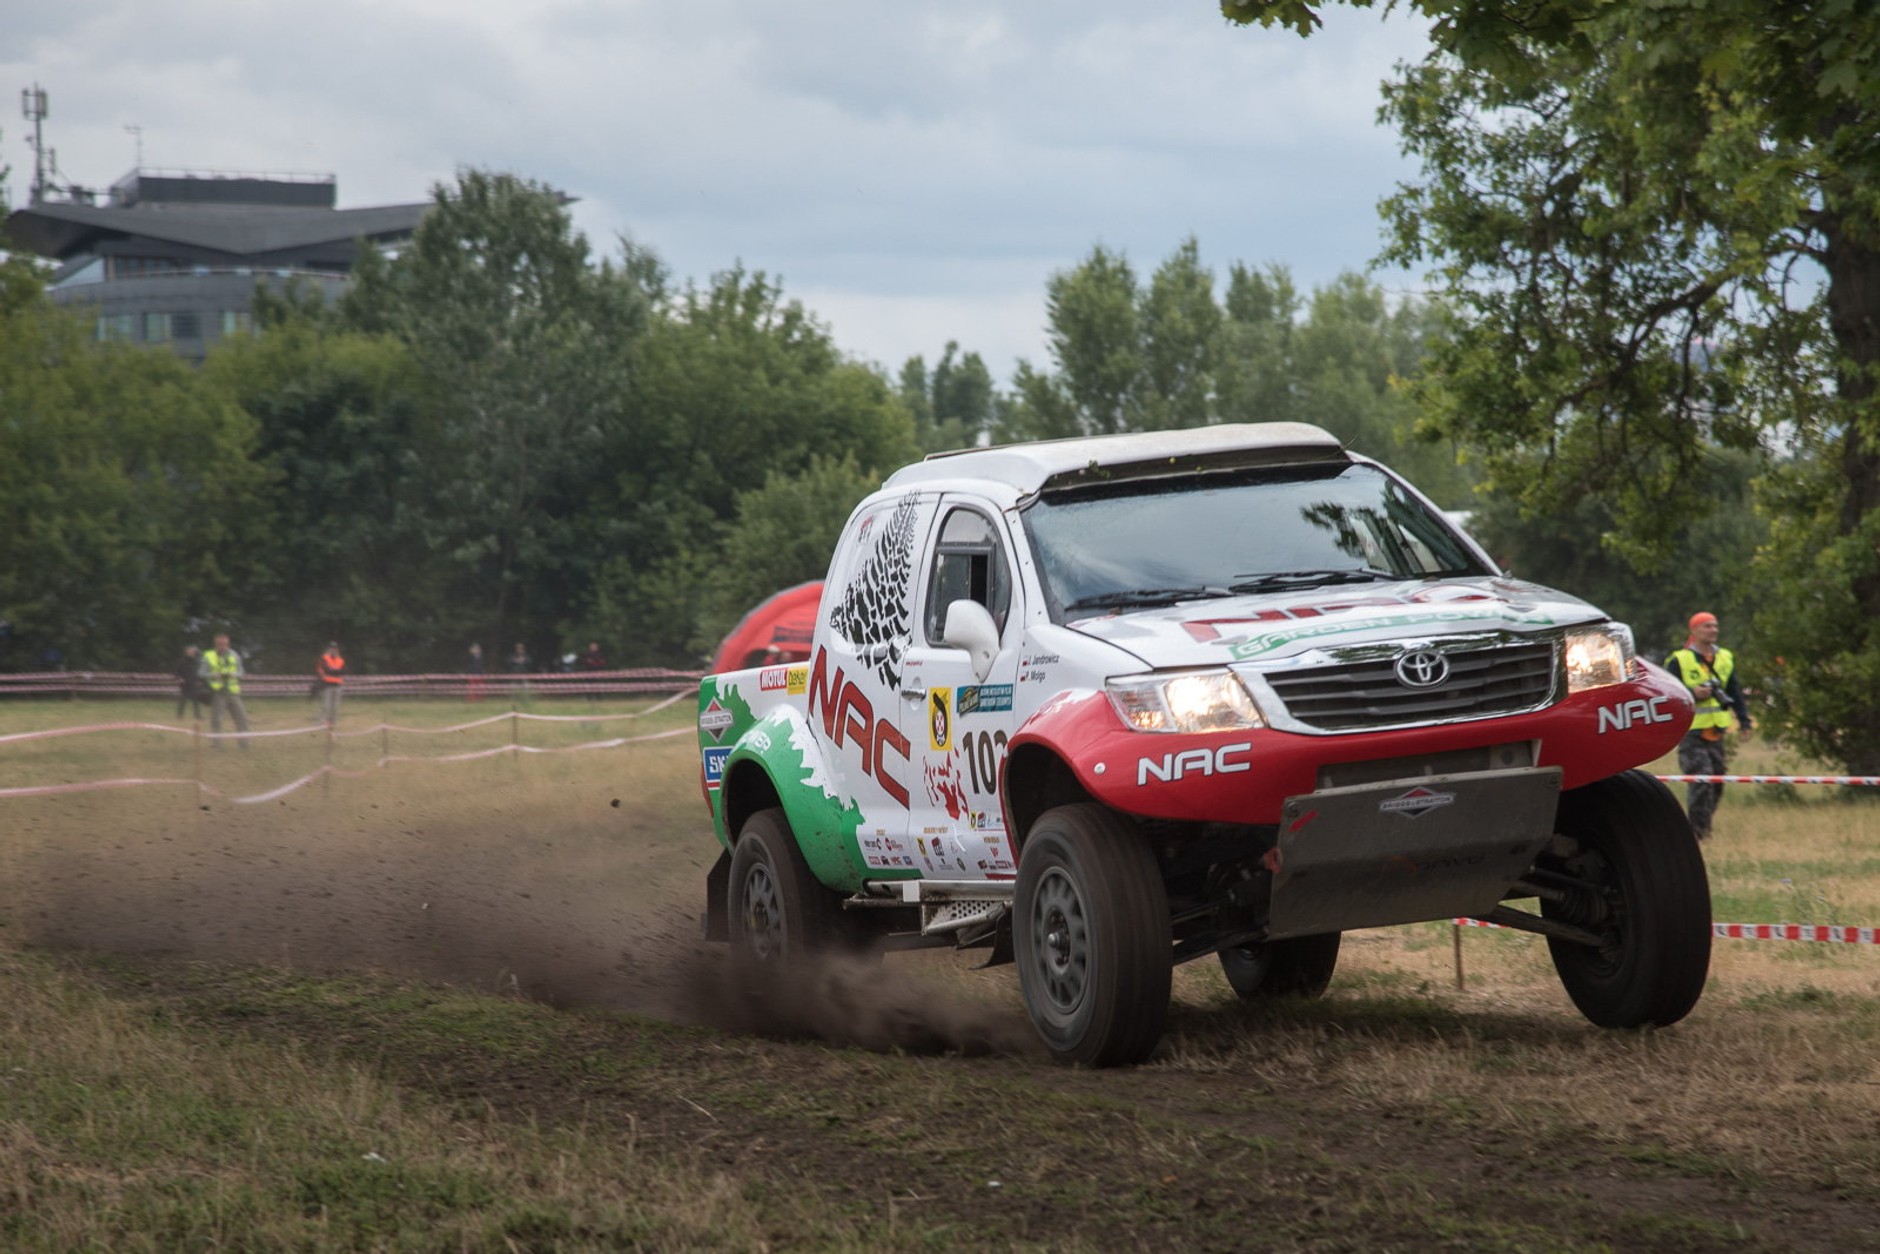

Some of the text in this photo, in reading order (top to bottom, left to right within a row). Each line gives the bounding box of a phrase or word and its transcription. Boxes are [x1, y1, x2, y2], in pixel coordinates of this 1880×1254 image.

[1235, 617, 1393, 656] GARDEN
[761, 669, 785, 688] MOTUL
[808, 643, 911, 811] NAC
[1597, 695, 1674, 734] NAC
[708, 755, 729, 774] SK
[962, 729, 1009, 796] 10
[1137, 741, 1252, 787] NAC
